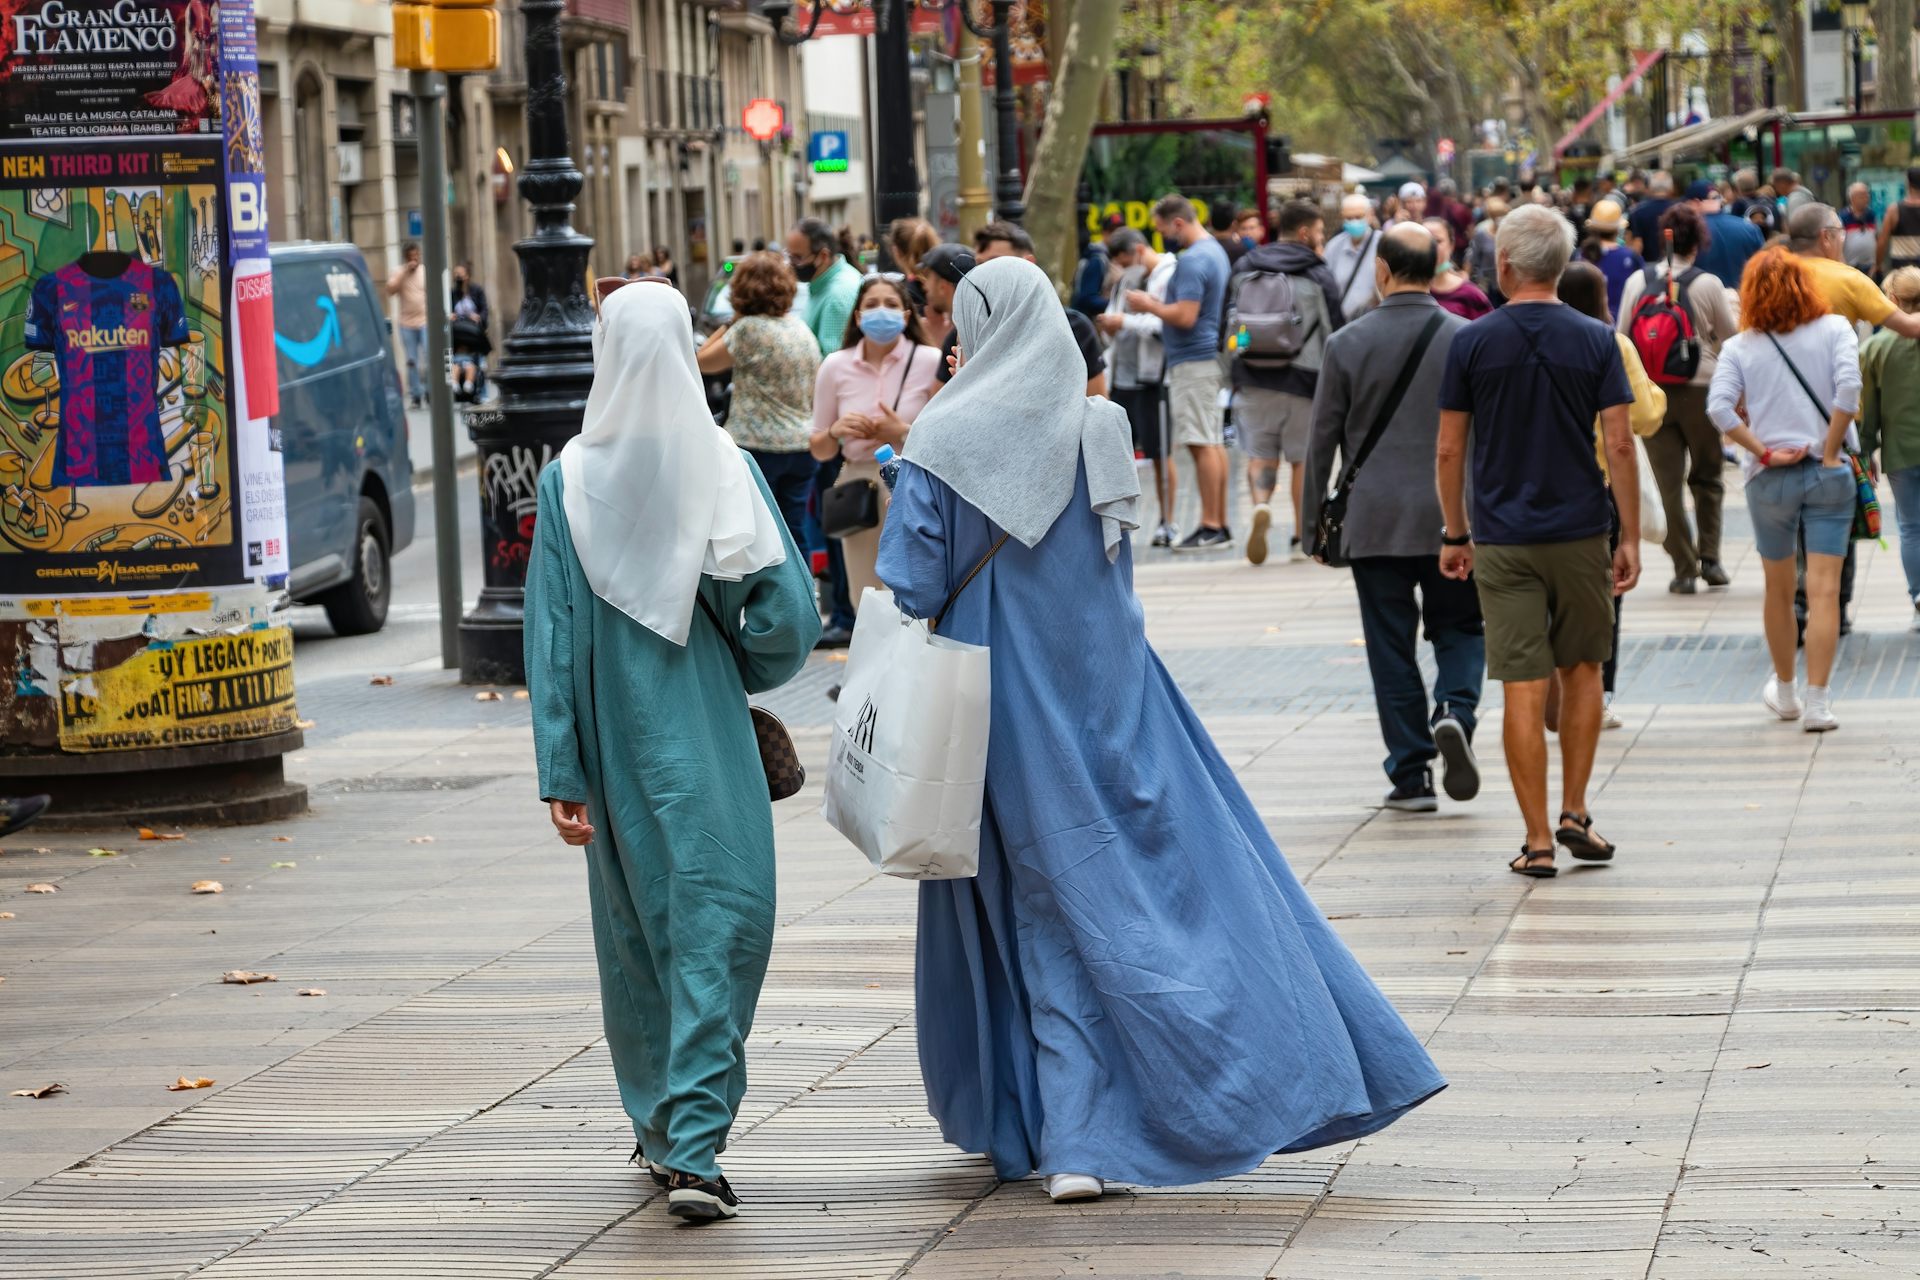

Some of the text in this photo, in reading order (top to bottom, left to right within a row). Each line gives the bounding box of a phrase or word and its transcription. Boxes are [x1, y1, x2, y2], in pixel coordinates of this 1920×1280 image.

[11, 15, 176, 54] FLAMENCO
[12, 65, 37, 74] DESDE
[39, 63, 89, 73] SEPTIEMBRE
[108, 62, 134, 70] HASTA
[136, 61, 161, 69] ENERO
[23, 73, 45, 81] FROM
[47, 71, 91, 80] SEPTEMBER
[121, 70, 156, 79] JANUARY
[25, 109, 177, 122] PALAU DE LA MUSICA CATALANA
[31, 126, 67, 136] TEATRE
[69, 124, 129, 135] POLIORAMA
[130, 123, 174, 134] (RAMBLA)
[820, 135, 840, 158] P
[3, 153, 149, 178] NEW THIRD KIT
[66, 325, 148, 348] Rakuten
[36, 567, 98, 578] CREATED
[117, 562, 200, 575] BARCELONA
[193, 637, 254, 674] LEGACY
[262, 639, 281, 662] PORT
[176, 681, 213, 714] FINS
[218, 679, 231, 709] A
